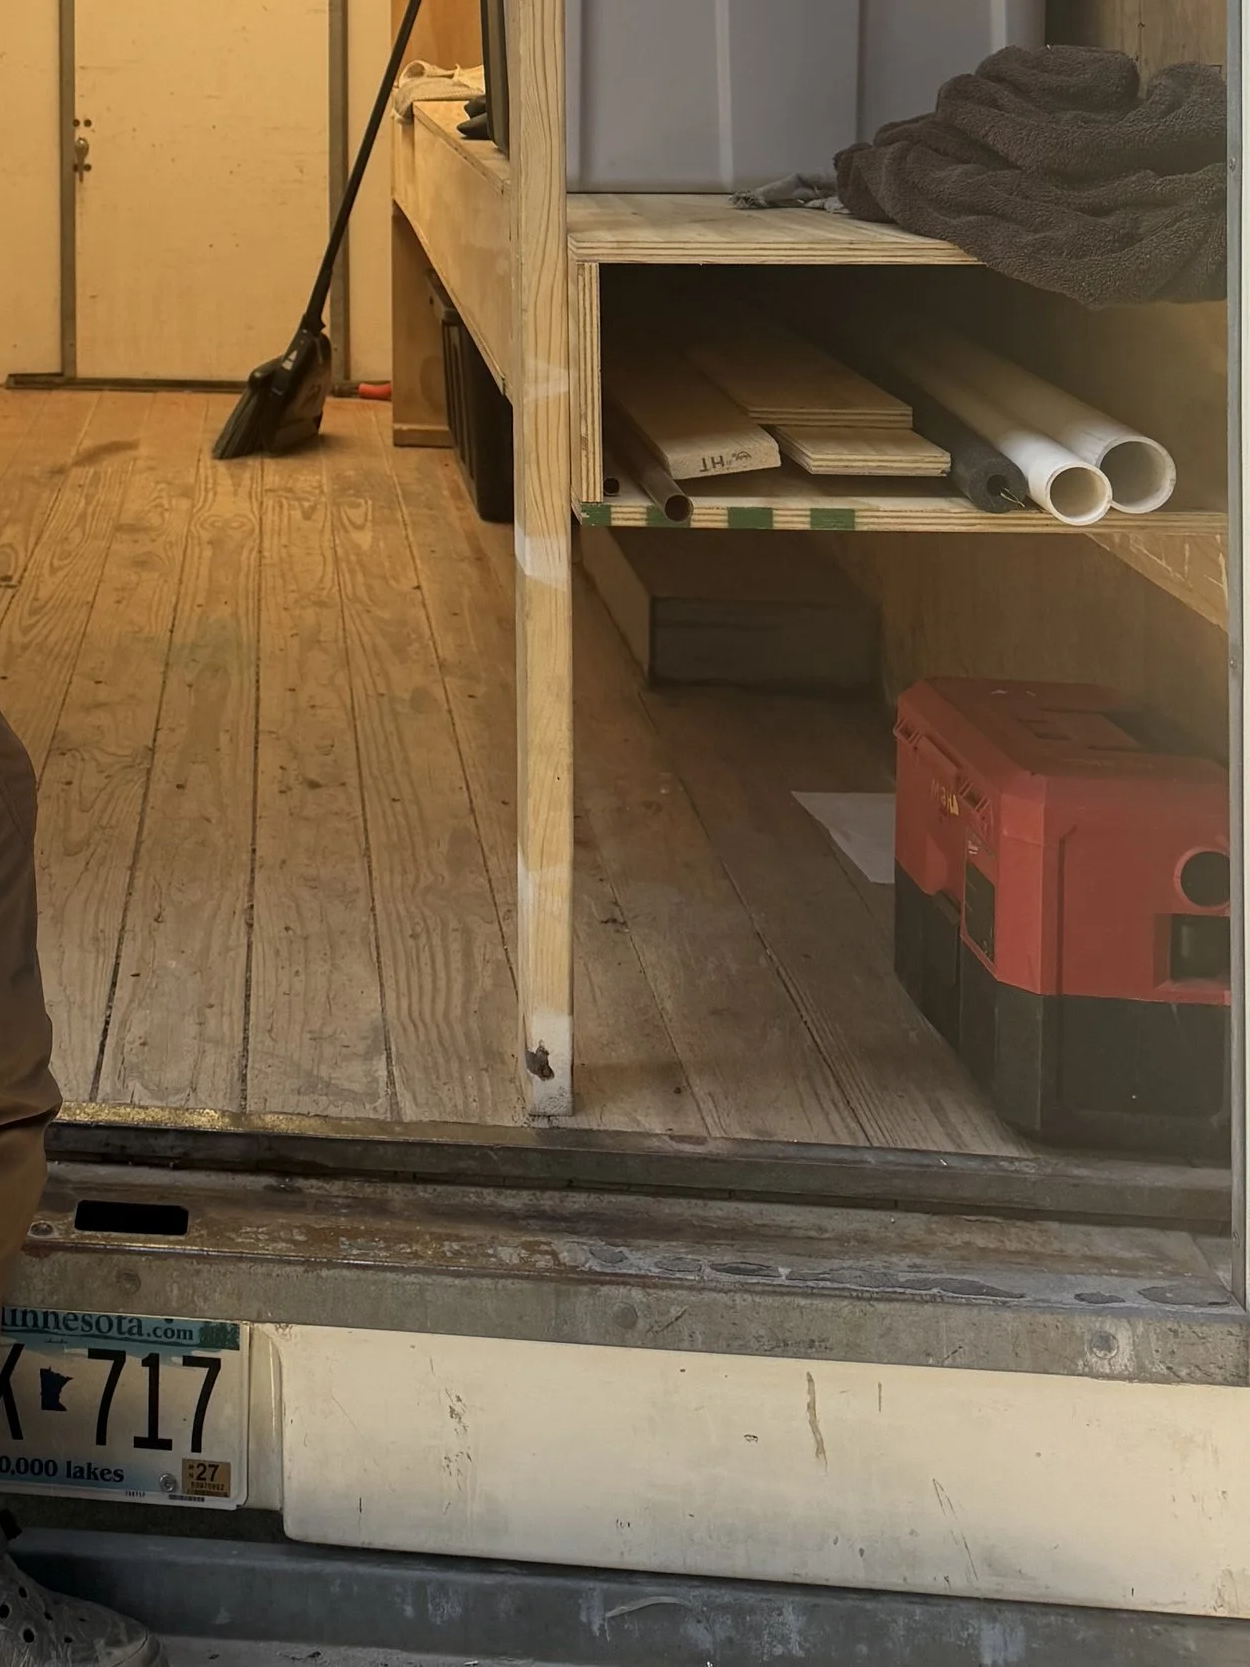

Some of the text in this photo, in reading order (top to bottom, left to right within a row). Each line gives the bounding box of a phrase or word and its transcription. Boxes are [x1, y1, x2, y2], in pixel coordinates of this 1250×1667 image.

[1, 1306, 194, 1340] innesota.com
[87, 1347, 222, 1454] 717
[66, 1460, 125, 1483] lakes
[196, 1462, 220, 1482] 27
